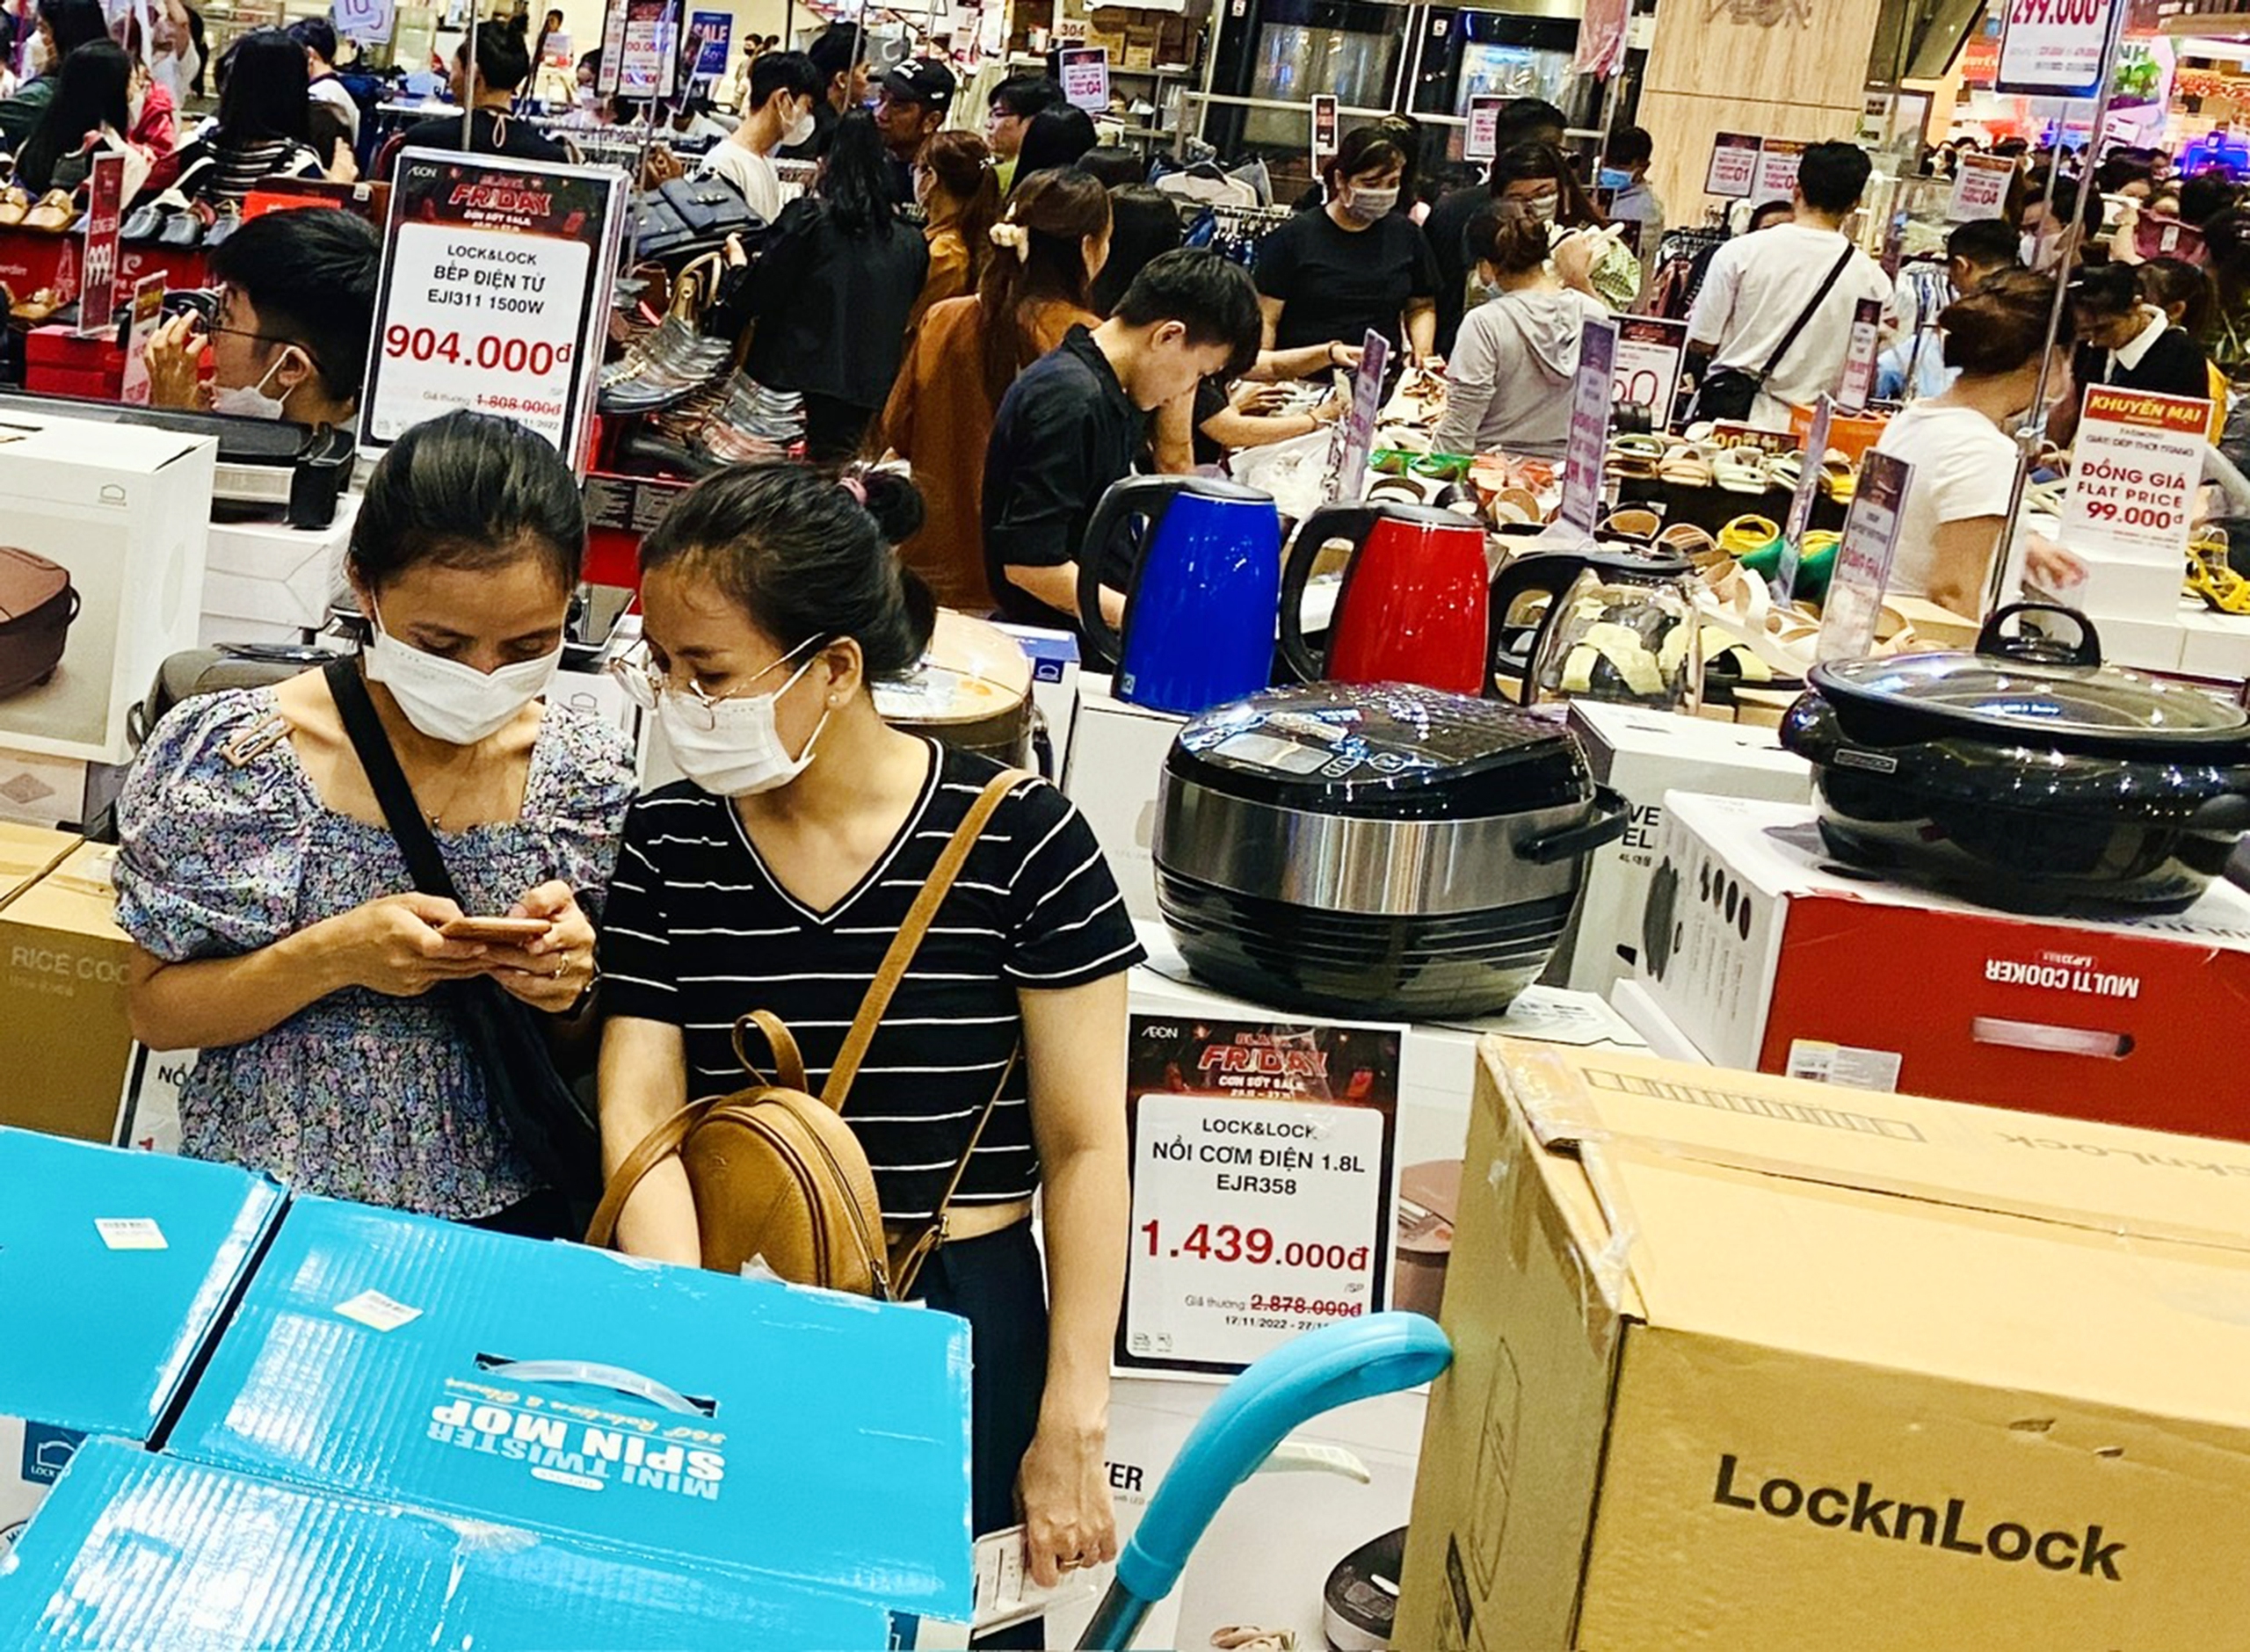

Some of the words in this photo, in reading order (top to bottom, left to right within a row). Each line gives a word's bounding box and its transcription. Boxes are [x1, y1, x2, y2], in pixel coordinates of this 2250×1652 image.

[693, 23, 729, 43] SALE
[449, 183, 552, 216] FRIDAY
[447, 244, 537, 265] LOCK&LOCK
[433, 260, 469, 281] BẾP
[474, 270, 516, 290] ĐIỆN
[428, 288, 482, 308] EJI311
[490, 296, 545, 315] 1500W
[385, 324, 572, 375] 904.000đ
[2090, 395, 2165, 418] KHUYẾN
[2081, 458, 2143, 483] ĐỒNG
[2149, 473, 2186, 490] GIÁ
[2077, 482, 2118, 497] FLAT
[2125, 489, 2183, 509] PRICE
[2087, 501, 2184, 529] 99.000đ
[11, 946, 71, 975] RICE
[1985, 959, 2069, 989] COOKER
[2072, 970, 2139, 998] MULTI
[1198, 1044, 1328, 1077] FRIDAY
[1202, 1118, 1317, 1141] LOCK&LOCK
[1200, 1144, 1252, 1165] CƠM
[1259, 1147, 1313, 1172] ĐIỆN
[1321, 1154, 1365, 1173] 1.8L
[1217, 1174, 1297, 1196] EJR358
[1141, 1220, 1369, 1272] 1.439.000đ
[1251, 1293, 1362, 1318] 2.878.000đ
[1226, 1315, 1288, 1329] 17/11/2022
[432, 1399, 568, 1451] MOP
[426, 1422, 610, 1479] TWISTER
[582, 1428, 726, 1482] SPIN
[621, 1465, 720, 1501] MINI
[1104, 1461, 1143, 1492] ER
[1713, 1454, 2128, 1582] LocknLock
